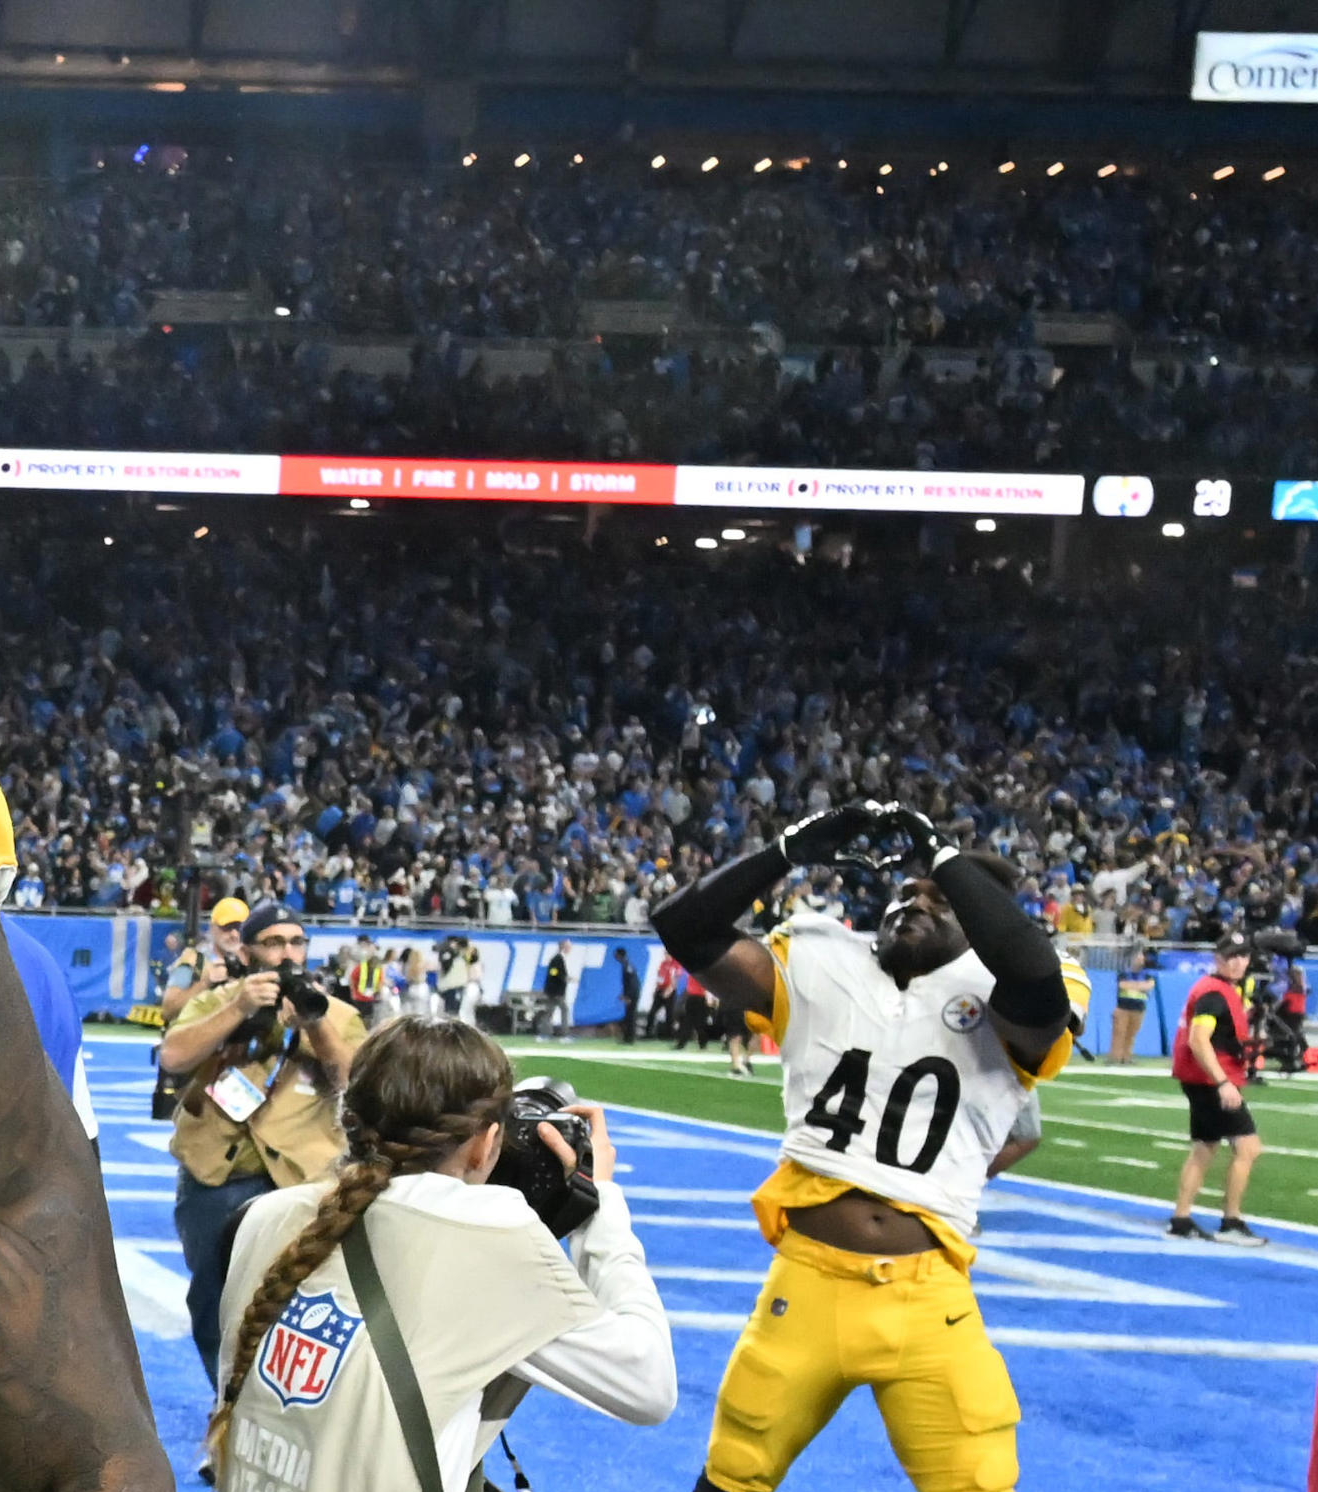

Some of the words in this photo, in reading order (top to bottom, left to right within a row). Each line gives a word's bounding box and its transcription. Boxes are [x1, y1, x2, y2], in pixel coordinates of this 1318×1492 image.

[28, 464, 115, 476] PROPERTY
[124, 466, 240, 479] RESTORATION
[320, 467, 383, 487] WATER
[413, 470, 455, 489] FIRE
[486, 471, 540, 491] MOLD
[570, 474, 635, 493] STORM
[715, 481, 781, 494] BELFOR
[923, 484, 1044, 500] RESTORATION
[804, 1049, 960, 1174] 40
[266, 1326, 329, 1395] NFL
[235, 1418, 311, 1492] MEDIA
